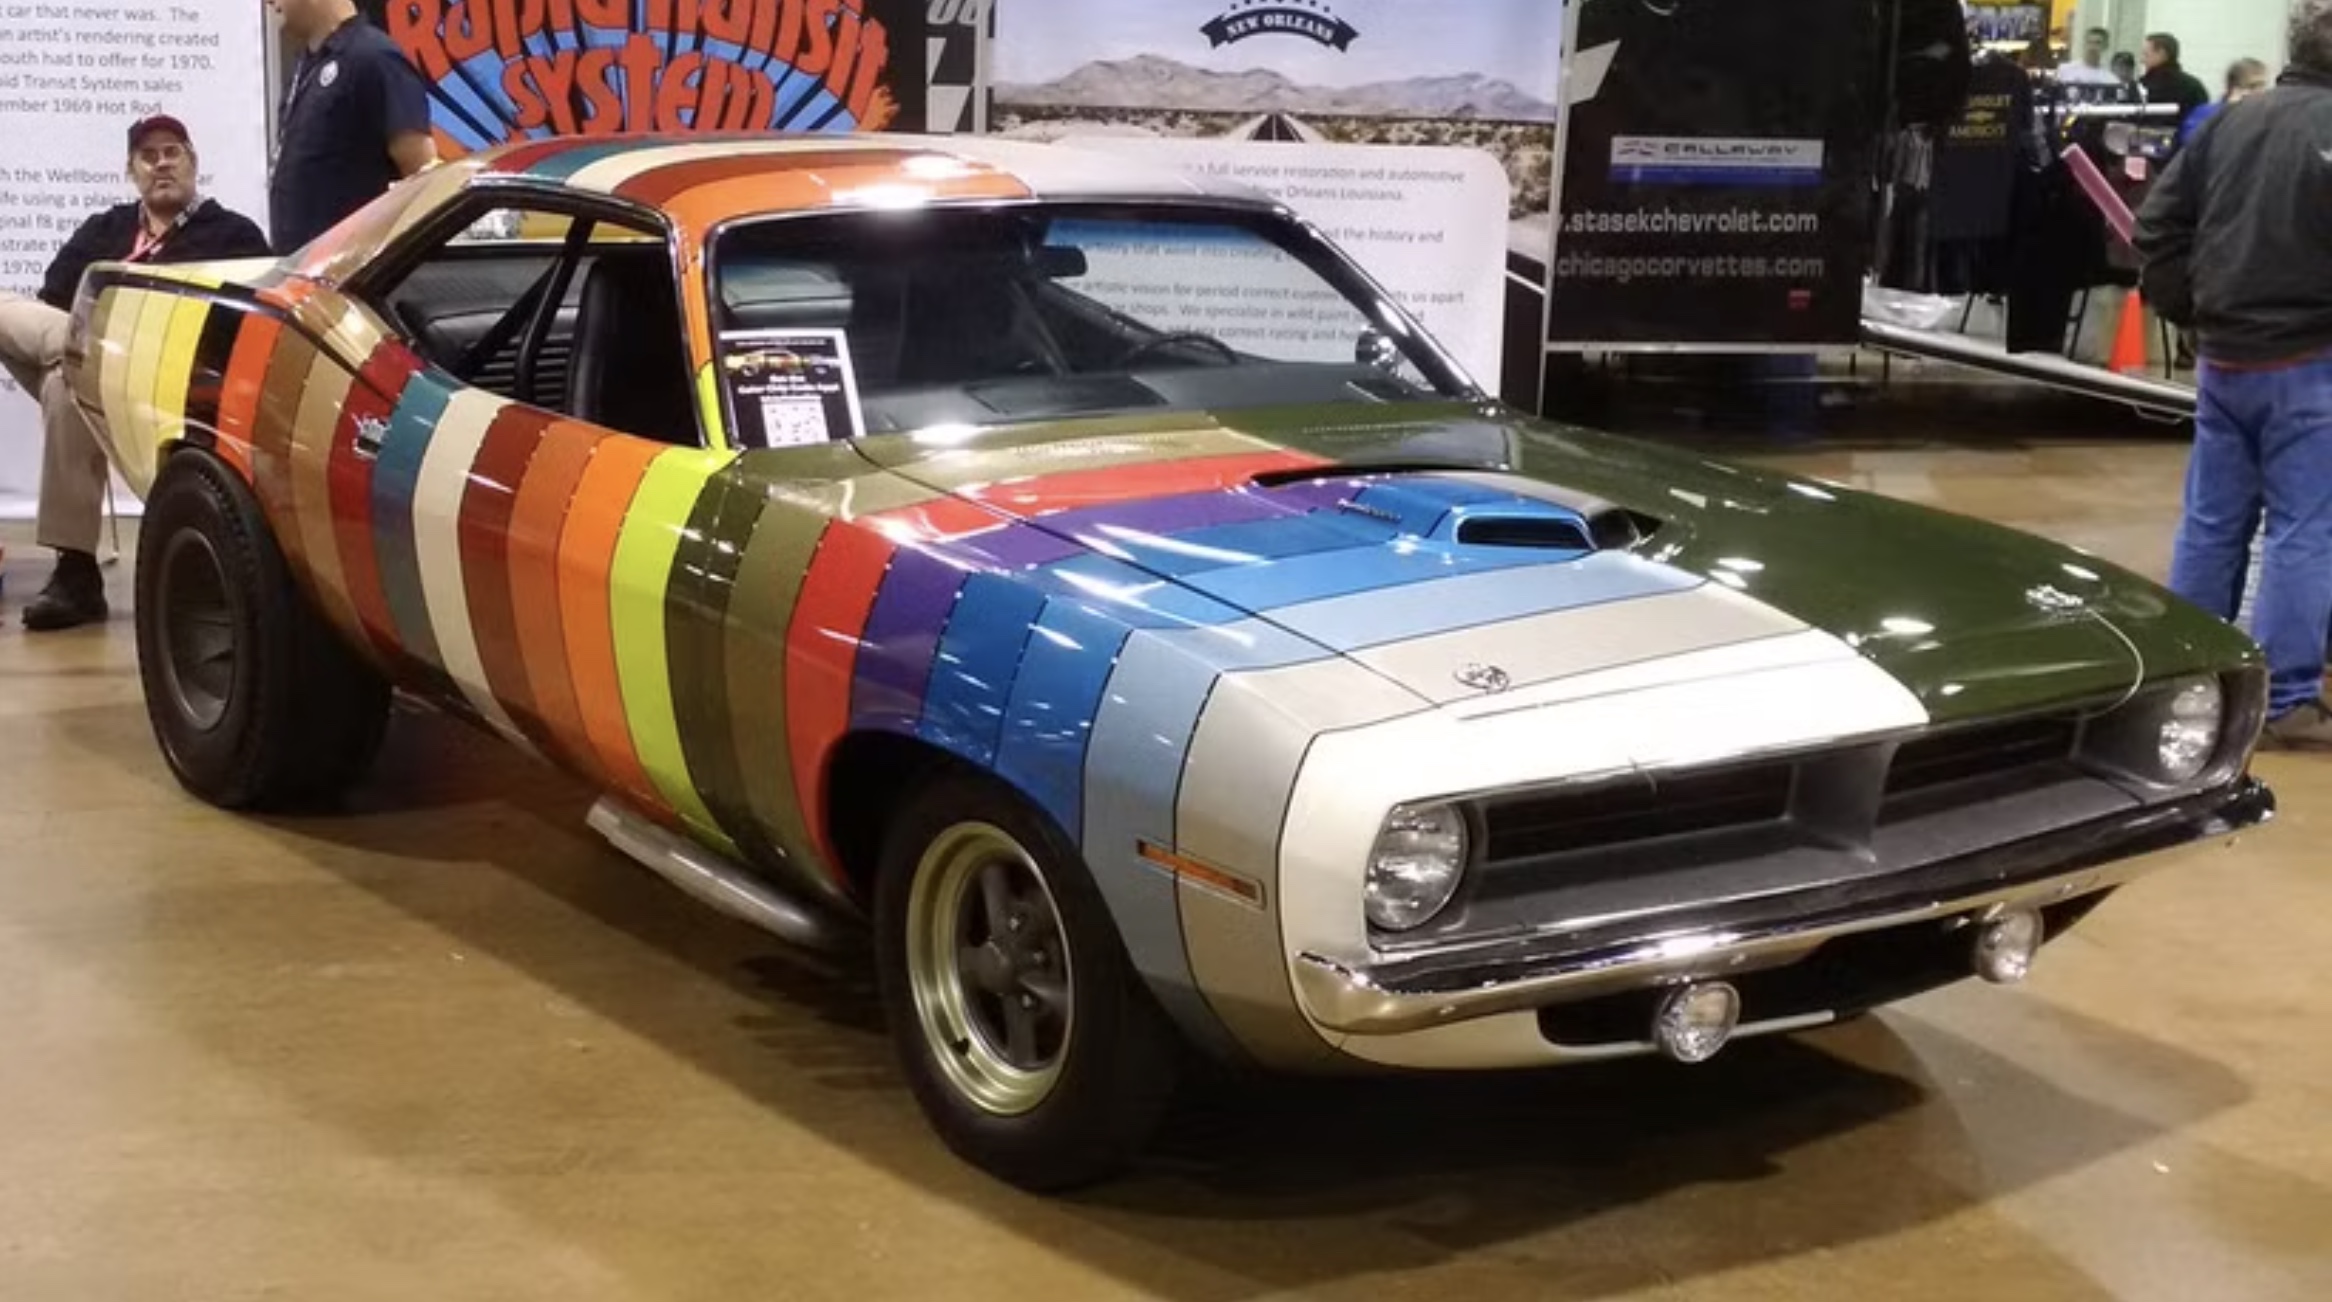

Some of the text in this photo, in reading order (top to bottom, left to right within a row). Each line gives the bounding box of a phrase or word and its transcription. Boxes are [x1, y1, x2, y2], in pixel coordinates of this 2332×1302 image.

[7, 6, 31, 19] car
[36, 6, 69, 19] that
[73, 7, 119, 20] never
[170, 7, 199, 22] The
[1226, 13, 1334, 41] NEW ORLEANS
[76, 31, 154, 47] rendering
[159, 32, 219, 47] created
[43, 53, 73, 67] had
[78, 53, 94, 67] to
[99, 53, 136, 68] offer
[141, 53, 165, 69] for
[171, 55, 215, 70] 1970.
[23, 74, 76, 90] Transit
[81, 75, 139, 93] System
[143, 77, 183, 92] sales
[53, 99, 93, 113] 1969
[96, 101, 126, 115] Hot
[1664, 142, 1799, 156] CALLAWAY
[15, 168, 42, 182] the
[47, 168, 119, 184] Wellborn
[1233, 165, 1279, 177] service
[1284, 166, 1355, 179] restoration
[1359, 167, 1384, 180] and
[1388, 168, 1465, 183] automotive
[1286, 185, 1336, 199] Orleans
[1561, 206, 1818, 233] .stasekchevrolet.com
[1369, 228, 1413, 243] history
[1419, 230, 1444, 243] and
